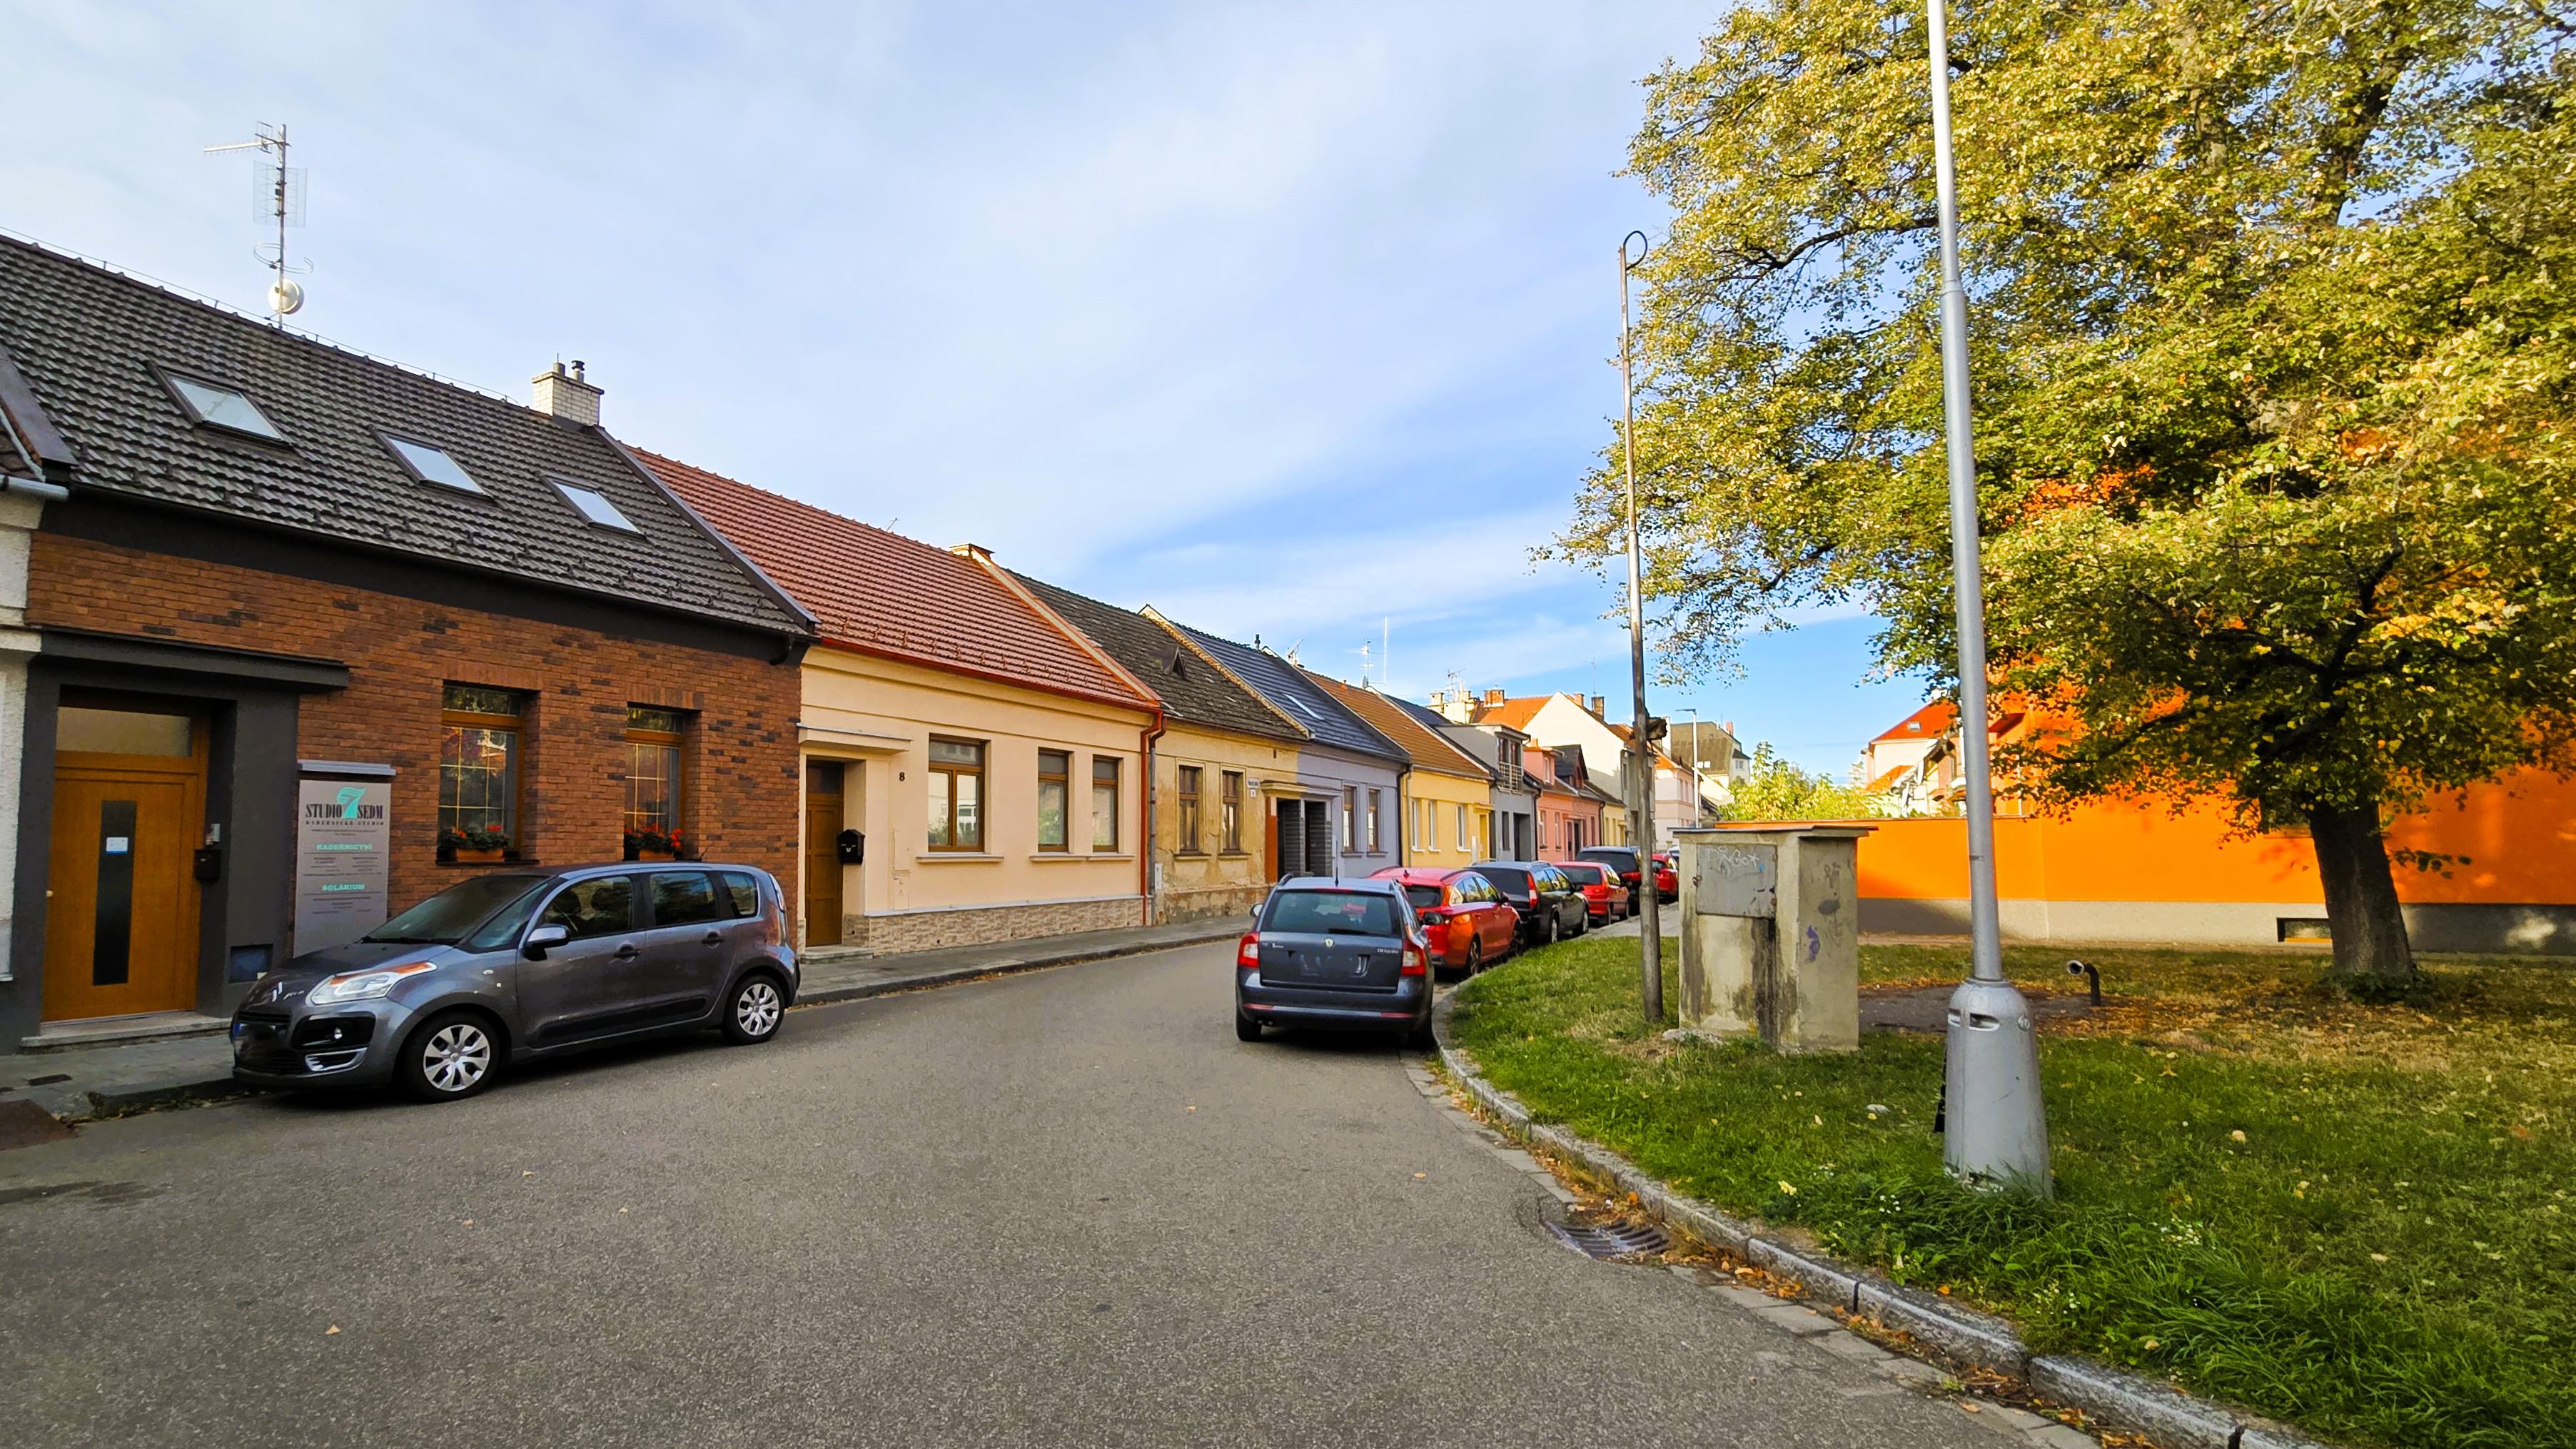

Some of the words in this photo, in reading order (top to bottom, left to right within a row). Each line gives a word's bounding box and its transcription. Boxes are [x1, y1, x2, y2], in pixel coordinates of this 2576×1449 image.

[899, 772, 905, 782] 8
[305, 804, 342, 818] STUDIO
[336, 787, 366, 819] 7
[357, 804, 383, 819] SEDM
